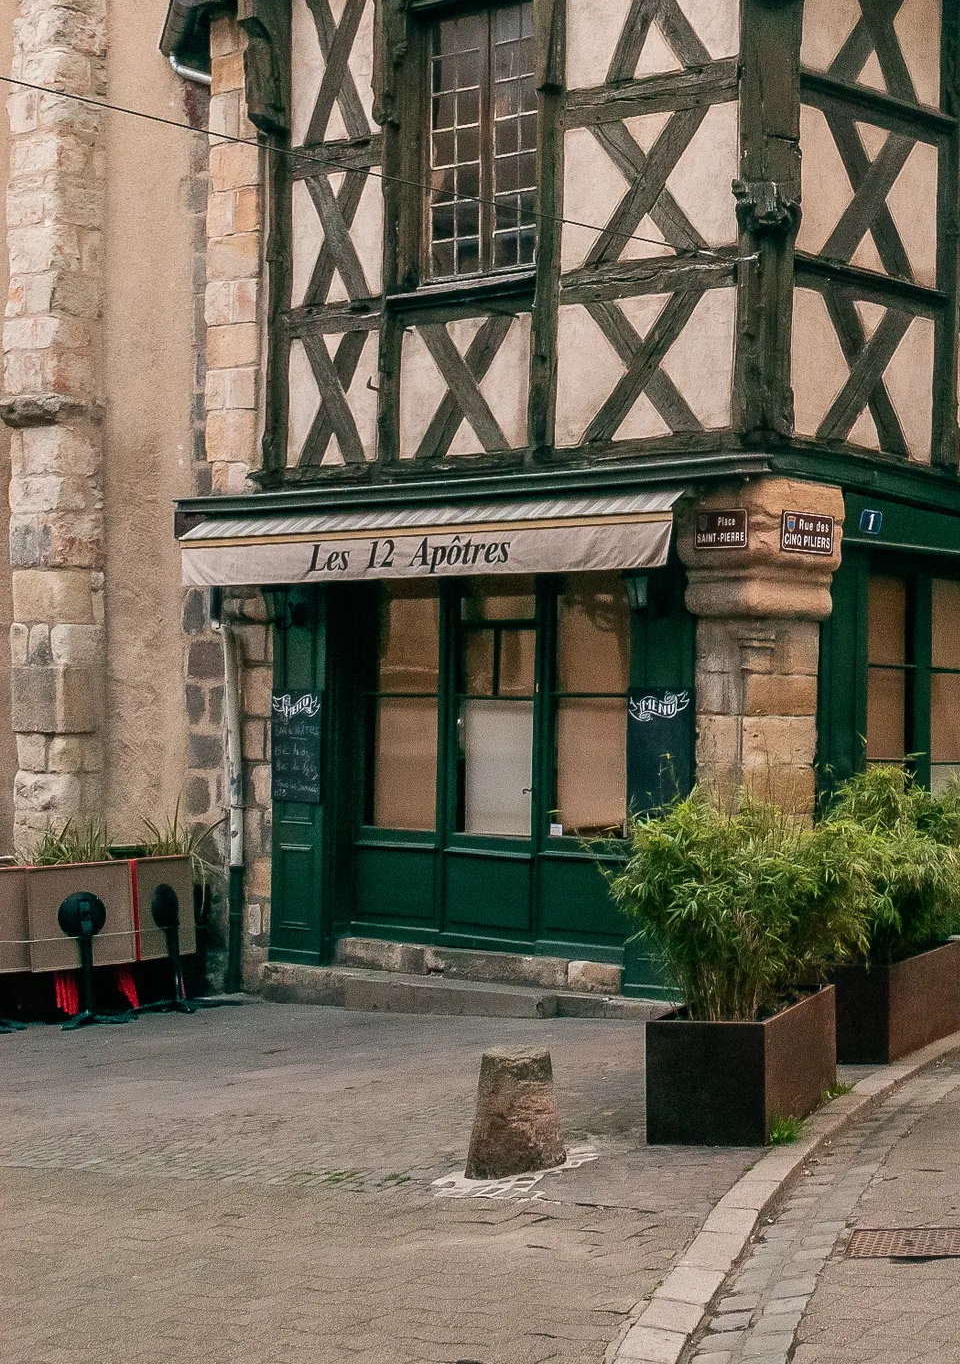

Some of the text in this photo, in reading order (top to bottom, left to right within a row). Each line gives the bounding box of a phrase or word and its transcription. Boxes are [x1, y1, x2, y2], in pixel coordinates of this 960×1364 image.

[717, 516, 736, 527] Place
[799, 519, 830, 533] Rue des
[867, 514, 876, 530] 1
[697, 531, 744, 543] SAINT-PIERRE
[784, 533, 831, 550] CINQ PILIERS
[308, 535, 512, 574] Les 12 Apôtres
[284, 696, 309, 716] MENU
[642, 699, 675, 716] MENU
